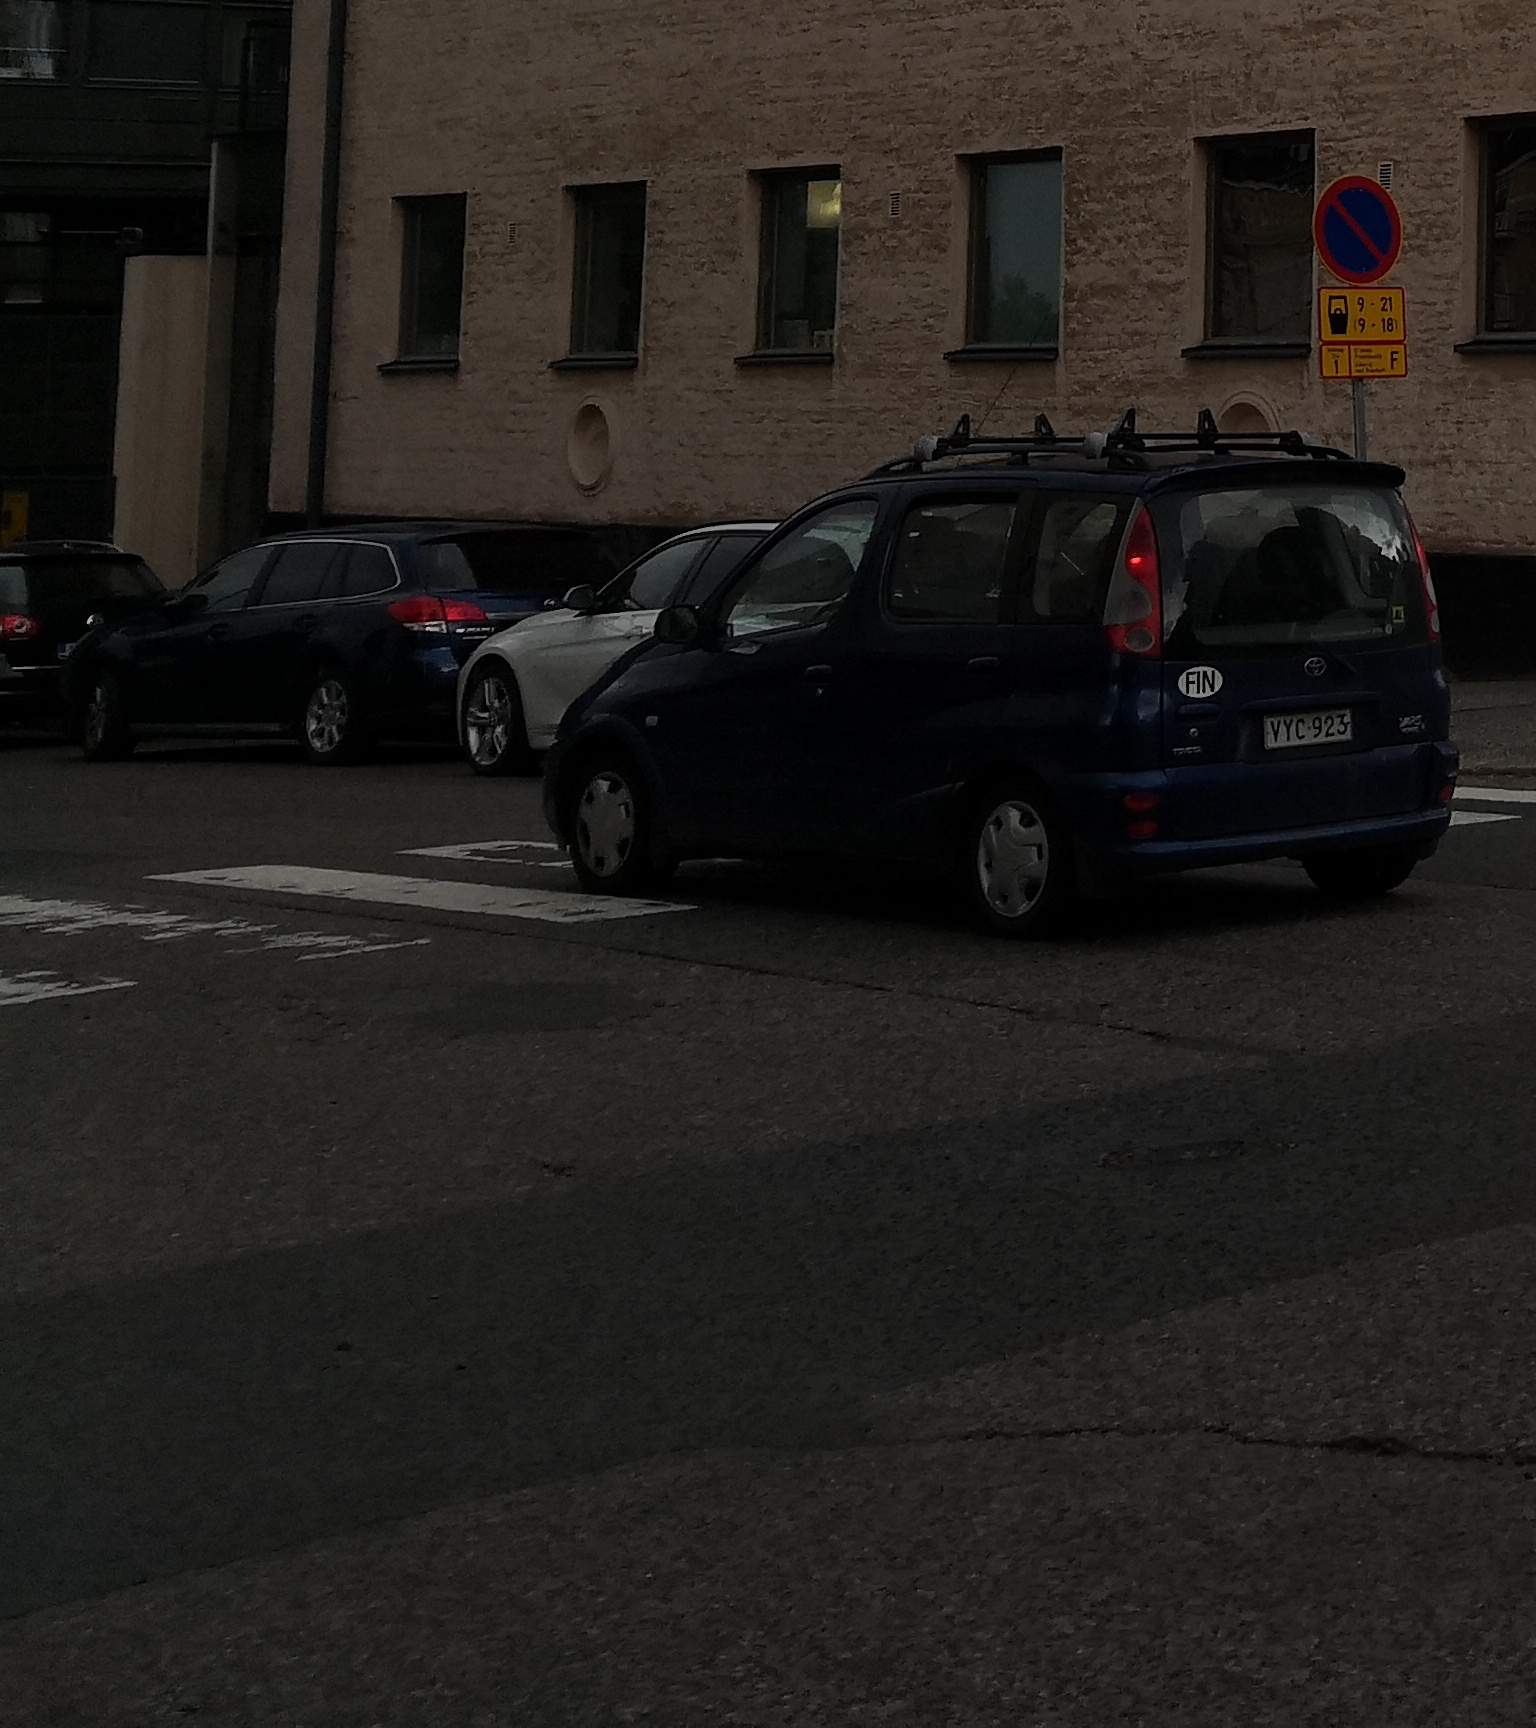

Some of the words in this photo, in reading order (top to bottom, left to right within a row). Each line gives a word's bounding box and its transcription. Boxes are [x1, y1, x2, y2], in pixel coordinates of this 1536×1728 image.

[1357, 297, 1365, 312] 9
[1380, 296, 1393, 312] 21
[1334, 359, 1339, 375] 1
[1390, 350, 1399, 370] F
[1186, 670, 1215, 694] FIN
